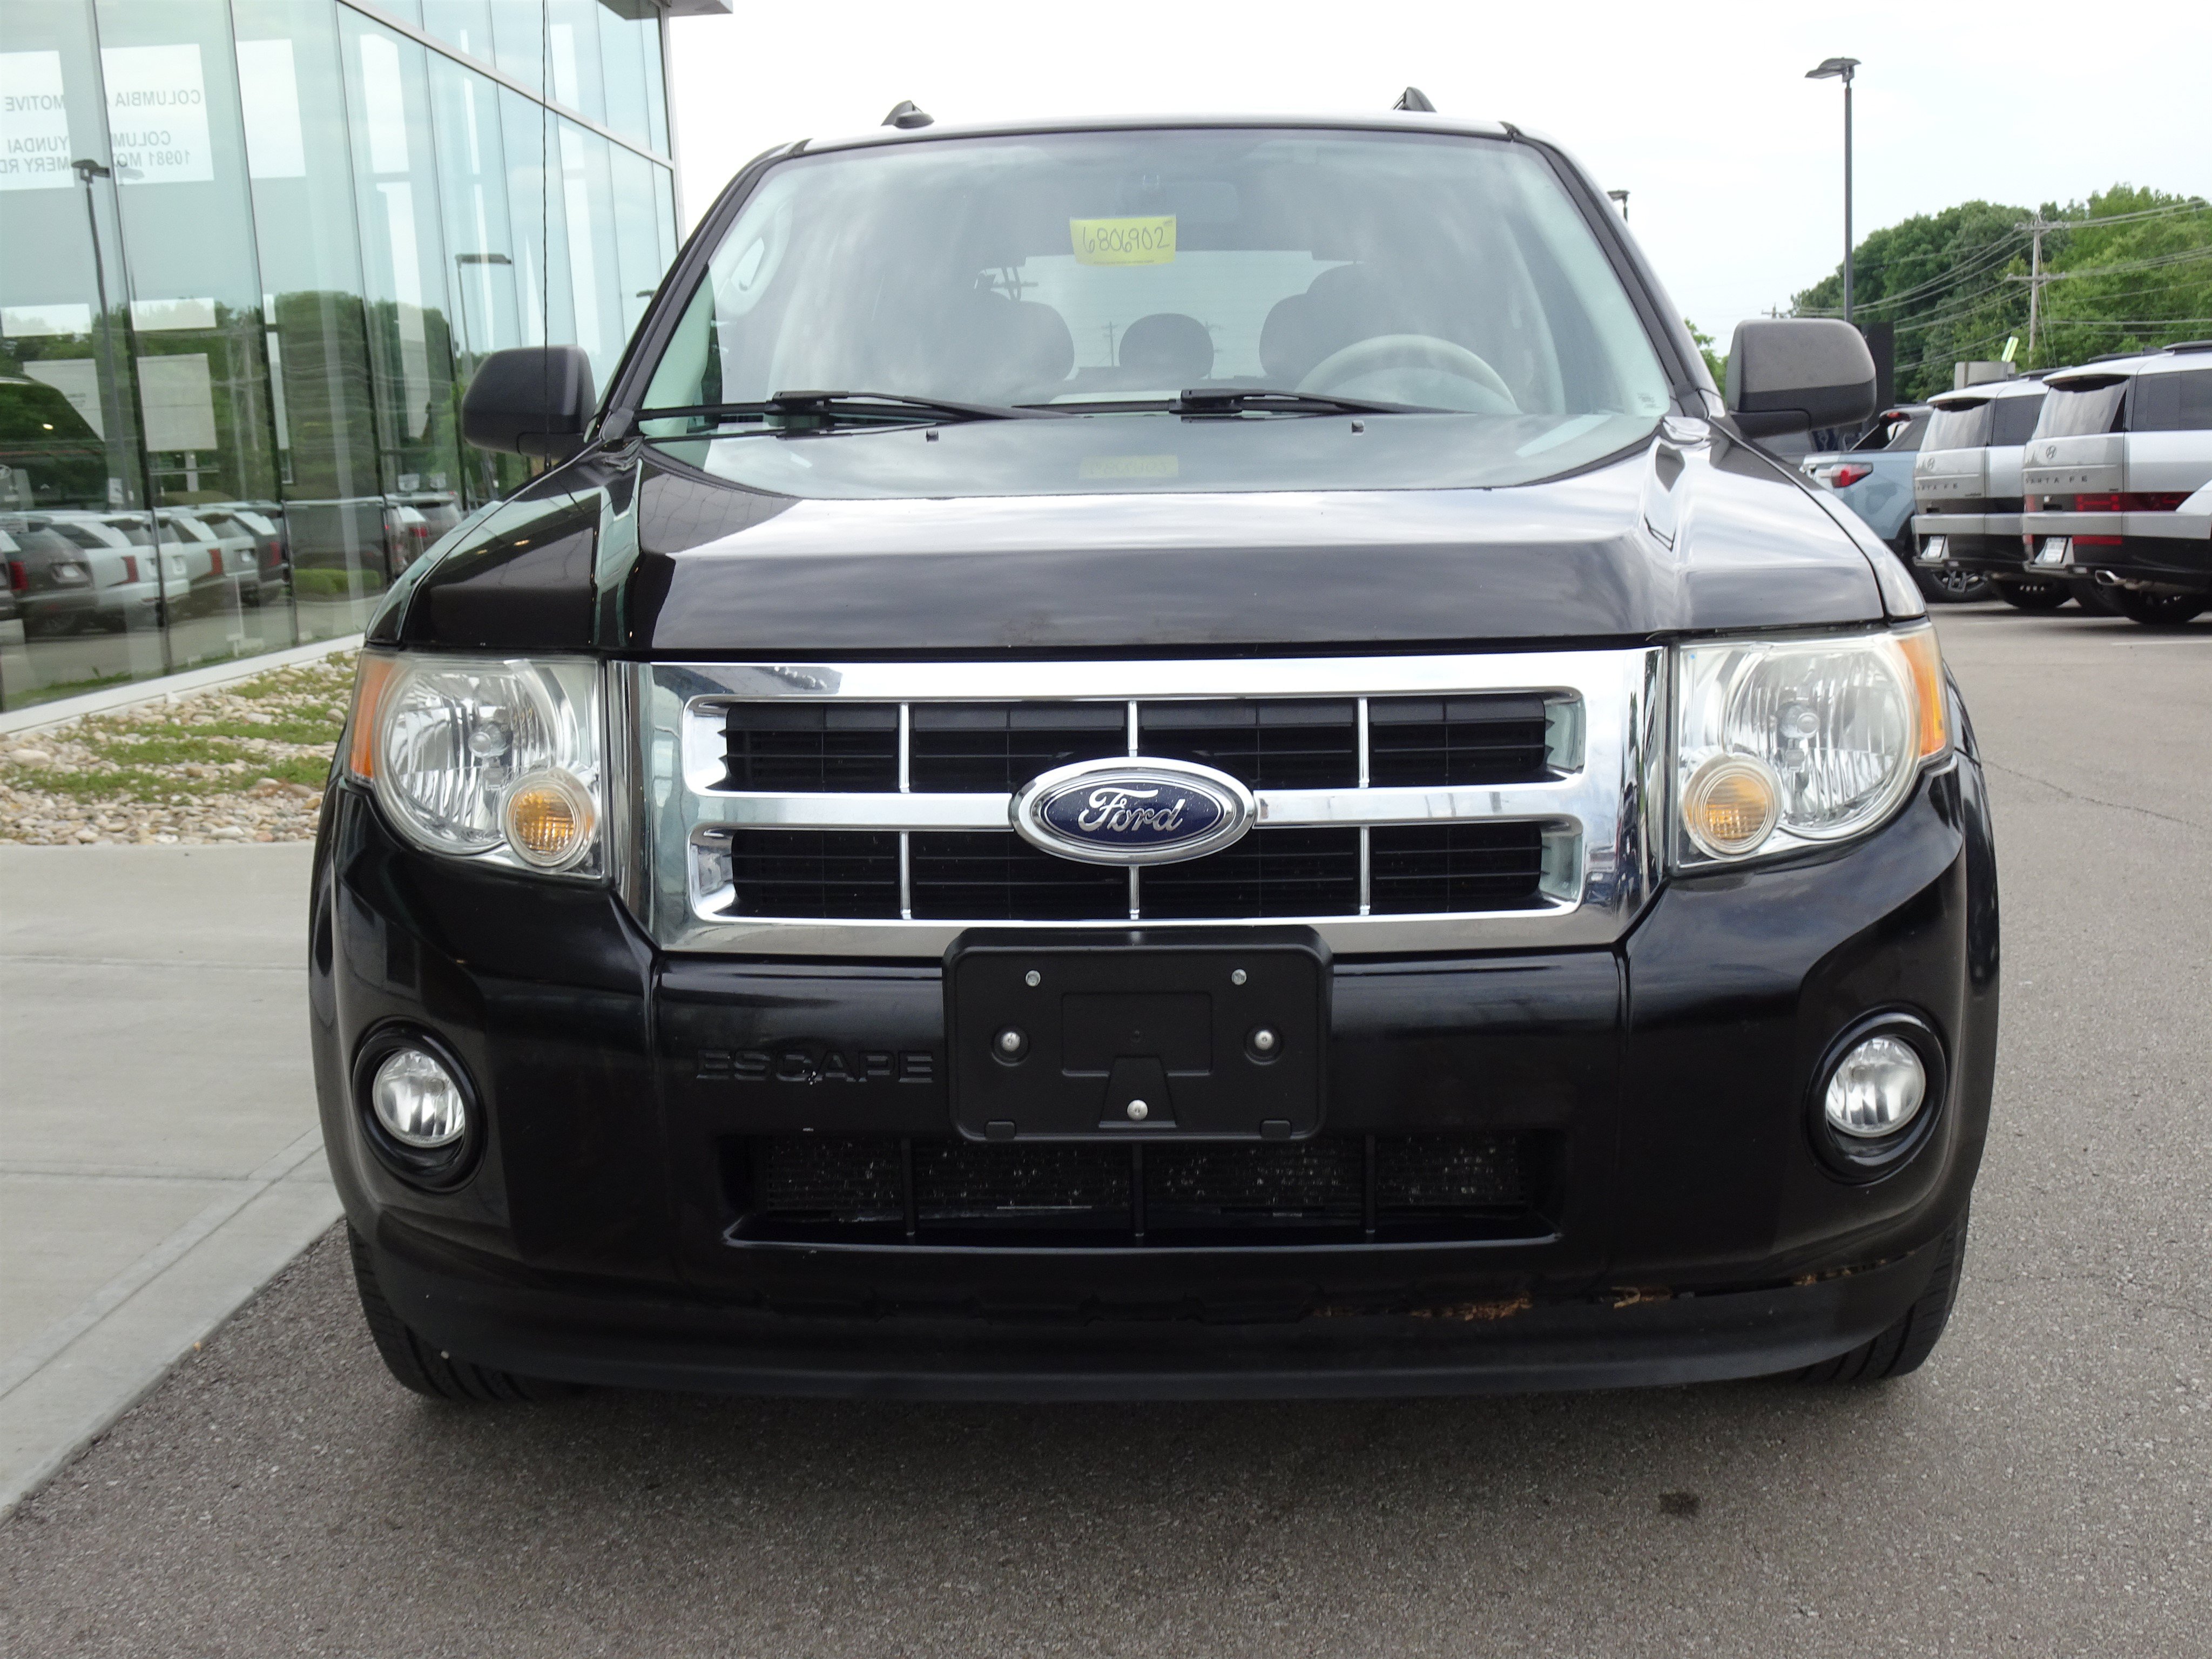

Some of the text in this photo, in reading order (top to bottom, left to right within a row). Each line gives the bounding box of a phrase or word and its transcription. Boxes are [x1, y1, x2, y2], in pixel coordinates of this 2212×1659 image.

[1083, 226, 1170, 253] 6806902
[1078, 787, 1185, 832] Ford
[696, 1049, 934, 1084] ESCAPE
